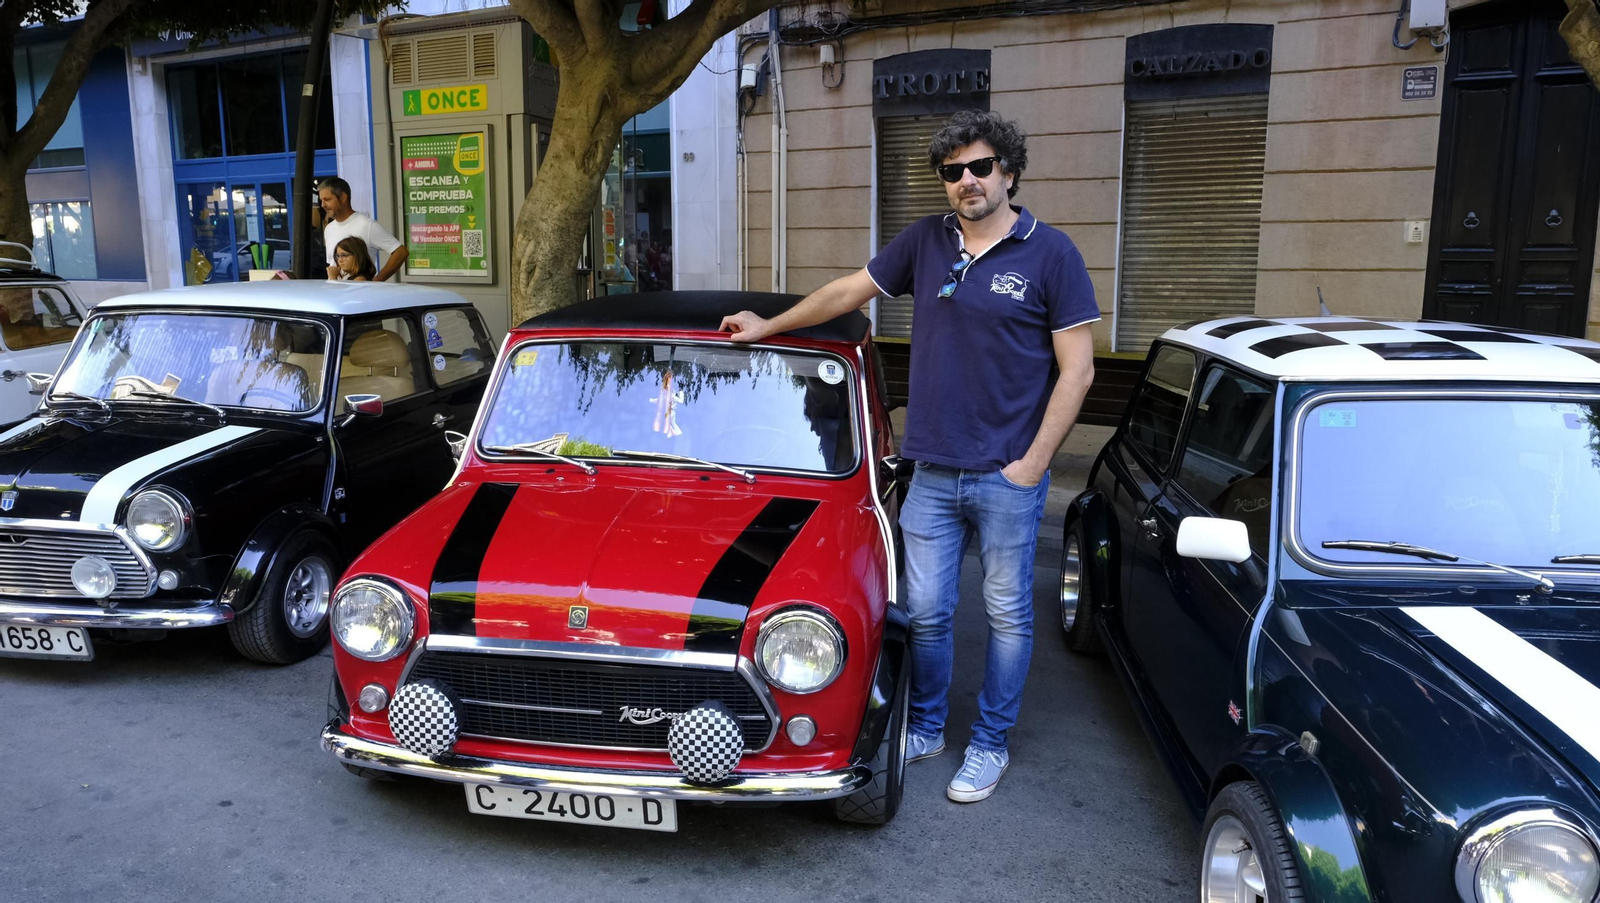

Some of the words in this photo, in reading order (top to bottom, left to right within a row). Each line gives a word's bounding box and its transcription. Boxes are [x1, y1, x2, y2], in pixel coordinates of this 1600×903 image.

[1130, 47, 1271, 77] CALZADO
[874, 68, 990, 99] TROTE
[427, 88, 481, 110] ONCE
[460, 152, 477, 160] ONCE
[414, 160, 435, 168] AHORA
[409, 175, 461, 187] ESCANEA
[463, 176, 469, 185] Y
[409, 189, 473, 201] COMPRUEBA
[410, 206, 427, 214] TUS
[428, 205, 465, 214] PREMIOS
[411, 225, 443, 233] descargando
[1233, 498, 1257, 513] Mini
[66, 630, 83, 652] C
[618, 705, 651, 725] Mini
[475, 785, 497, 810] C
[522, 789, 616, 821] 2400
[642, 797, 663, 825] D
